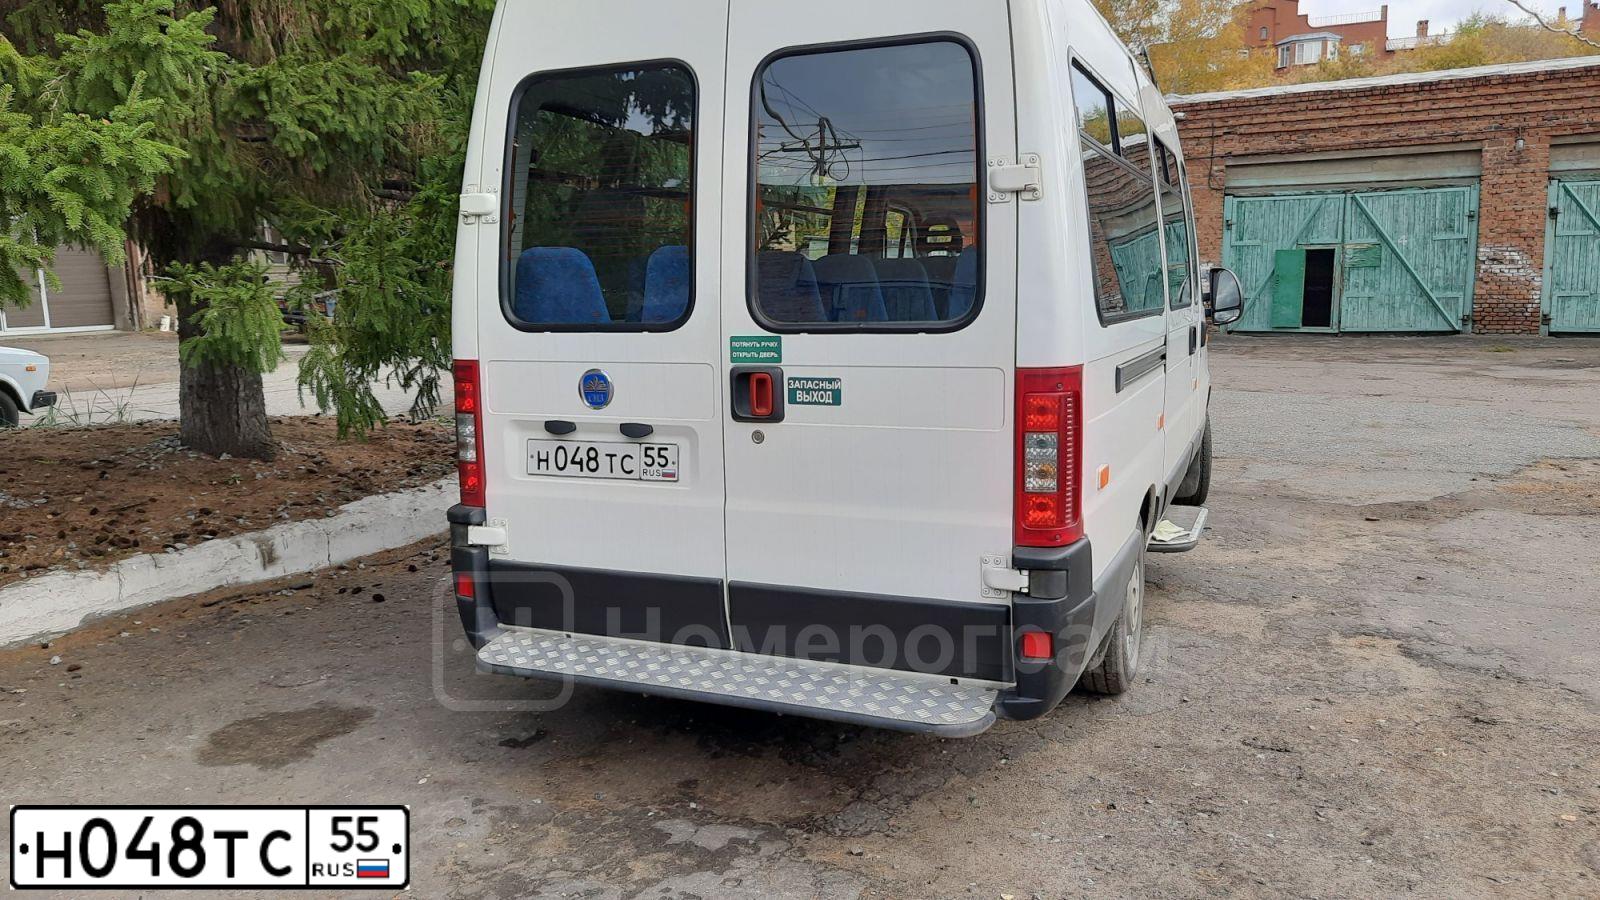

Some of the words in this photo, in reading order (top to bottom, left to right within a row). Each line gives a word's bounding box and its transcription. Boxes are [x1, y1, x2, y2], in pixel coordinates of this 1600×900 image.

[788, 379, 841, 390] ЗАПАСНЫЙ
[796, 390, 833, 404] ВЫХОД
[643, 446, 669, 468] 55
[642, 469, 661, 477] RUS
